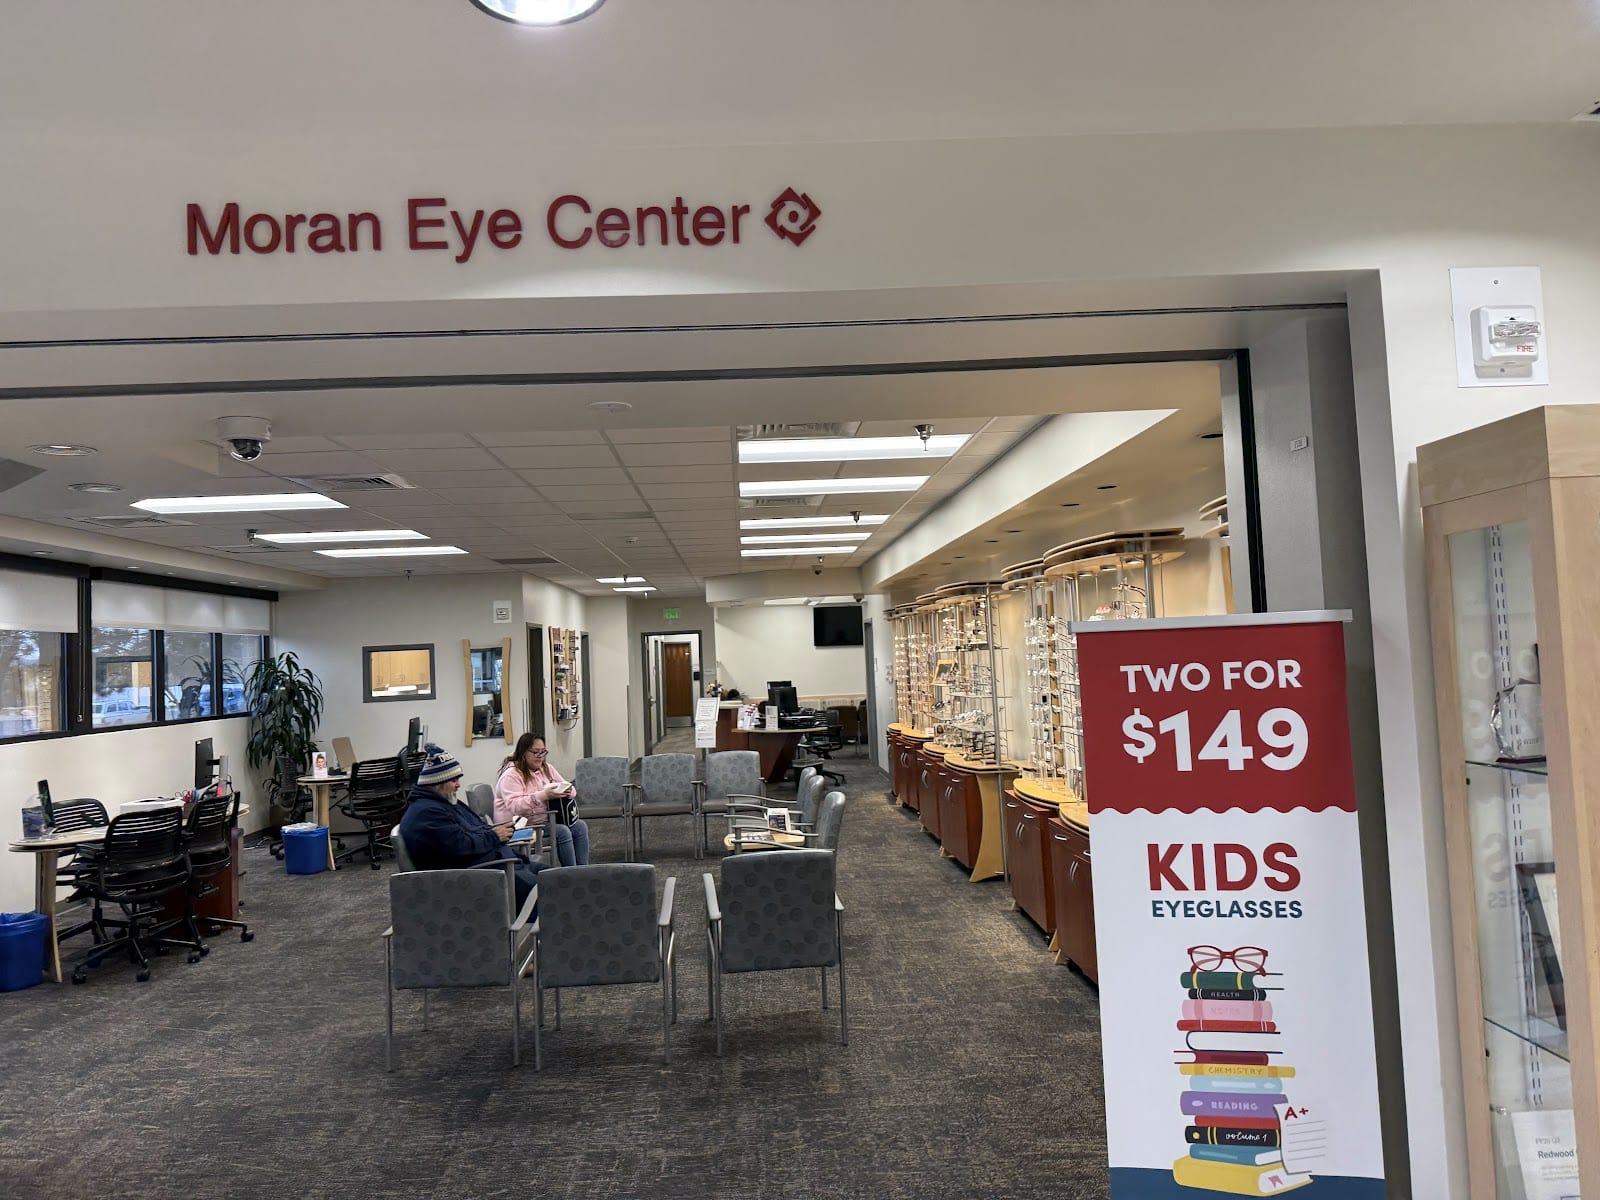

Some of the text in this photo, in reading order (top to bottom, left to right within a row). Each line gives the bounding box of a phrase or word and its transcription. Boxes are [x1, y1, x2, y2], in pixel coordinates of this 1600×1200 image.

[187, 194, 751, 263] Moran Eye Center
[1516, 345, 1535, 353] FIRE
[1119, 659, 1303, 693] TWO FOR
[1121, 706, 1309, 772] $149
[1147, 841, 1301, 893] KIDS
[1151, 900, 1303, 919] EYEGLASSES
[1208, 1066, 1264, 1075] CHEMISTRY
[1210, 1101, 1259, 1111] READING
[1284, 1105, 1310, 1121] A+
[1225, 1131, 1268, 1143] volume 1
[1537, 1149, 1575, 1159] Redwood
